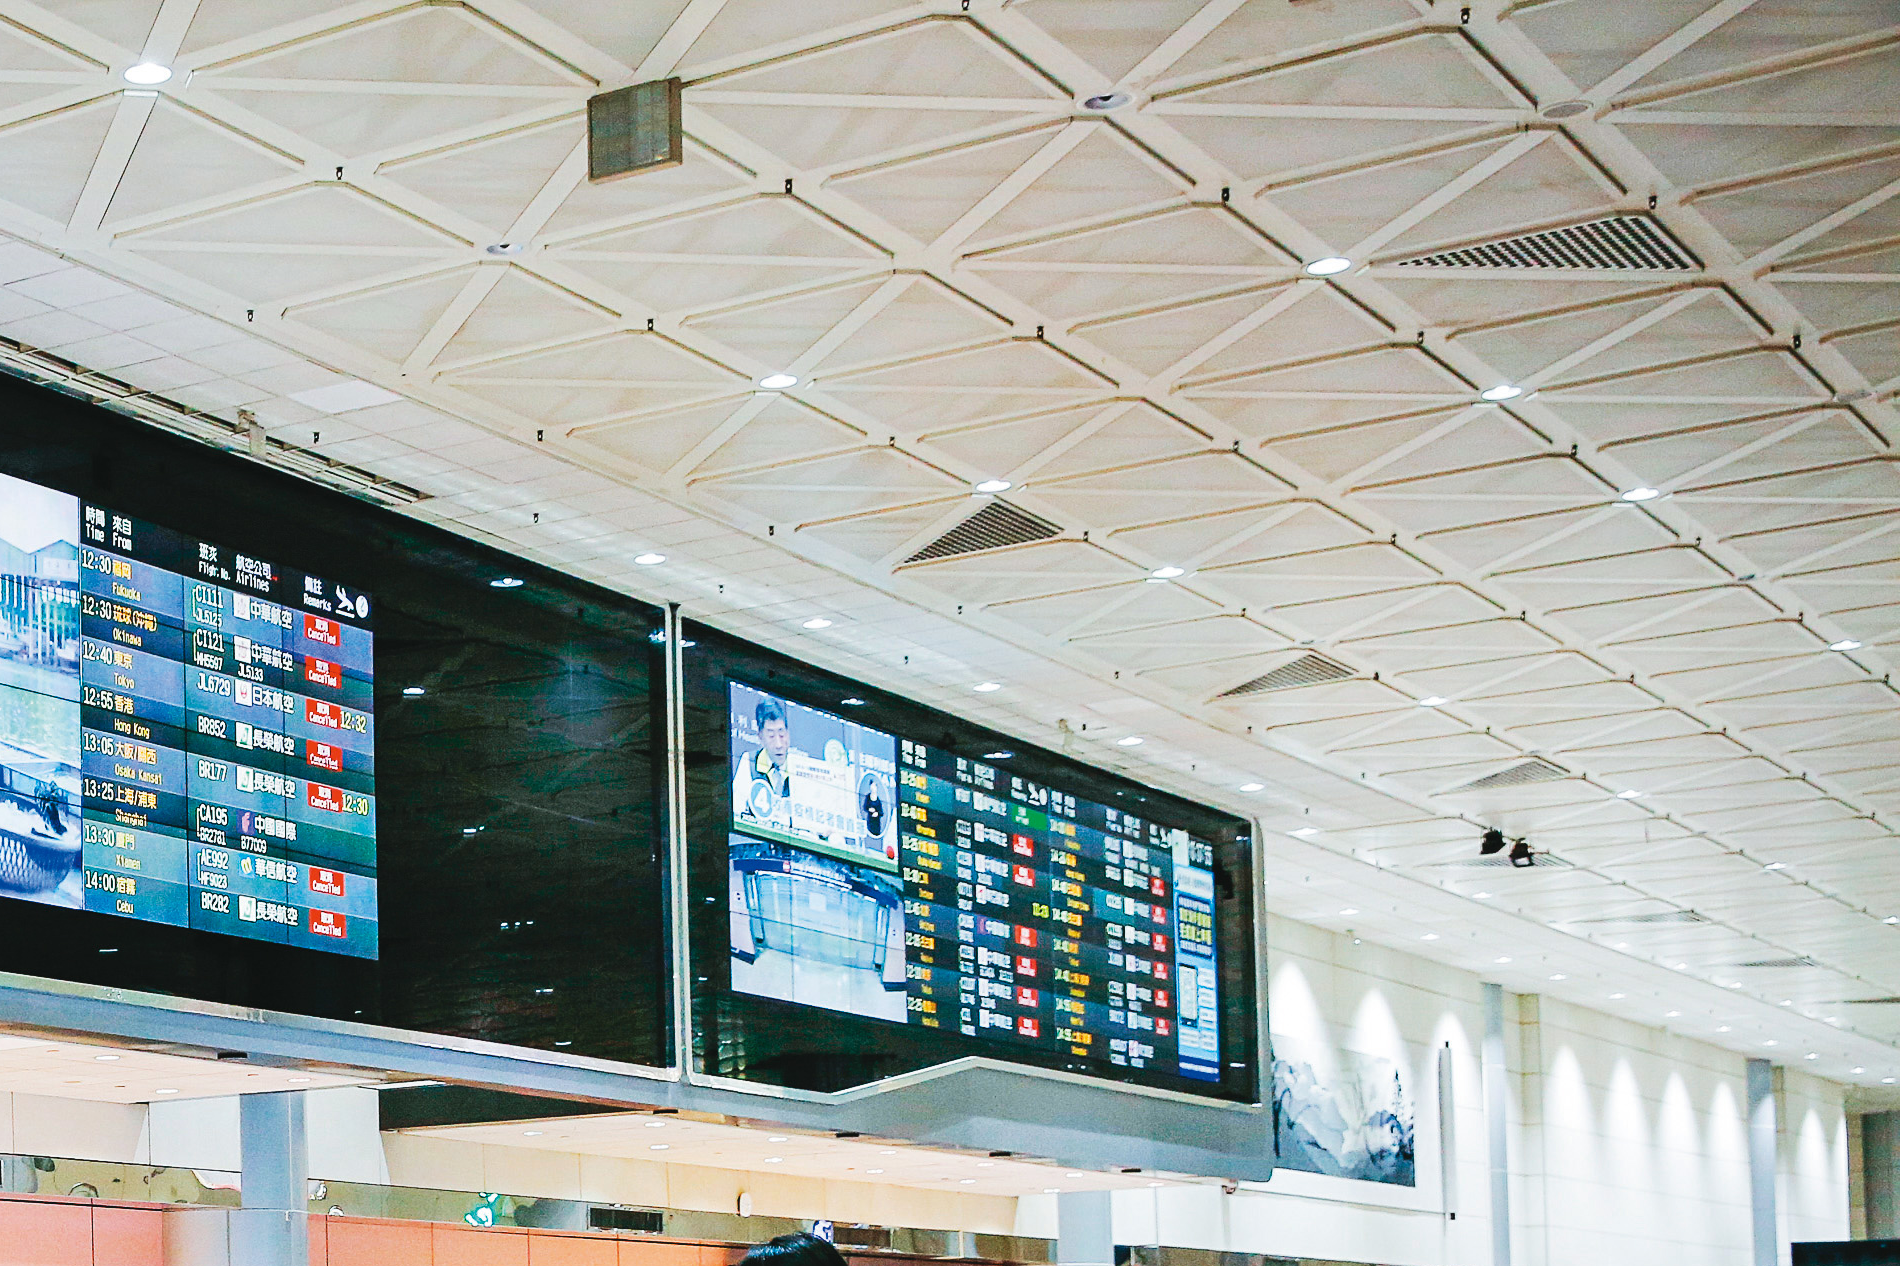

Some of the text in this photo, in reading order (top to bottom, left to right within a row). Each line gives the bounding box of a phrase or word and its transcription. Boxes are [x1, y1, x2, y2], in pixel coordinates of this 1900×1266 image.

[82, 550, 111, 574] 12:30
[196, 585, 223, 608] CI111
[82, 596, 112, 620] 12:30
[250, 604, 292, 630] 中華航空
[196, 629, 224, 652] CI121
[82, 641, 112, 664] 12:40
[252, 645, 293, 672] 中華航空
[198, 672, 230, 696] JL6729
[84, 687, 134, 714] 12:55 香港
[253, 686, 294, 713] 日本航空
[114, 718, 150, 739] Hong Kong
[198, 716, 226, 738] BR852
[84, 733, 114, 755] 13:05
[199, 760, 226, 782] BR177
[84, 779, 114, 800] 13:25
[200, 804, 228, 826] CA195
[342, 794, 368, 815] 12:30
[84, 825, 114, 846] 13:30
[201, 849, 228, 870] AE992
[86, 871, 115, 892] 14:00
[117, 900, 134, 914] Cebu
[202, 892, 229, 913] BR282
